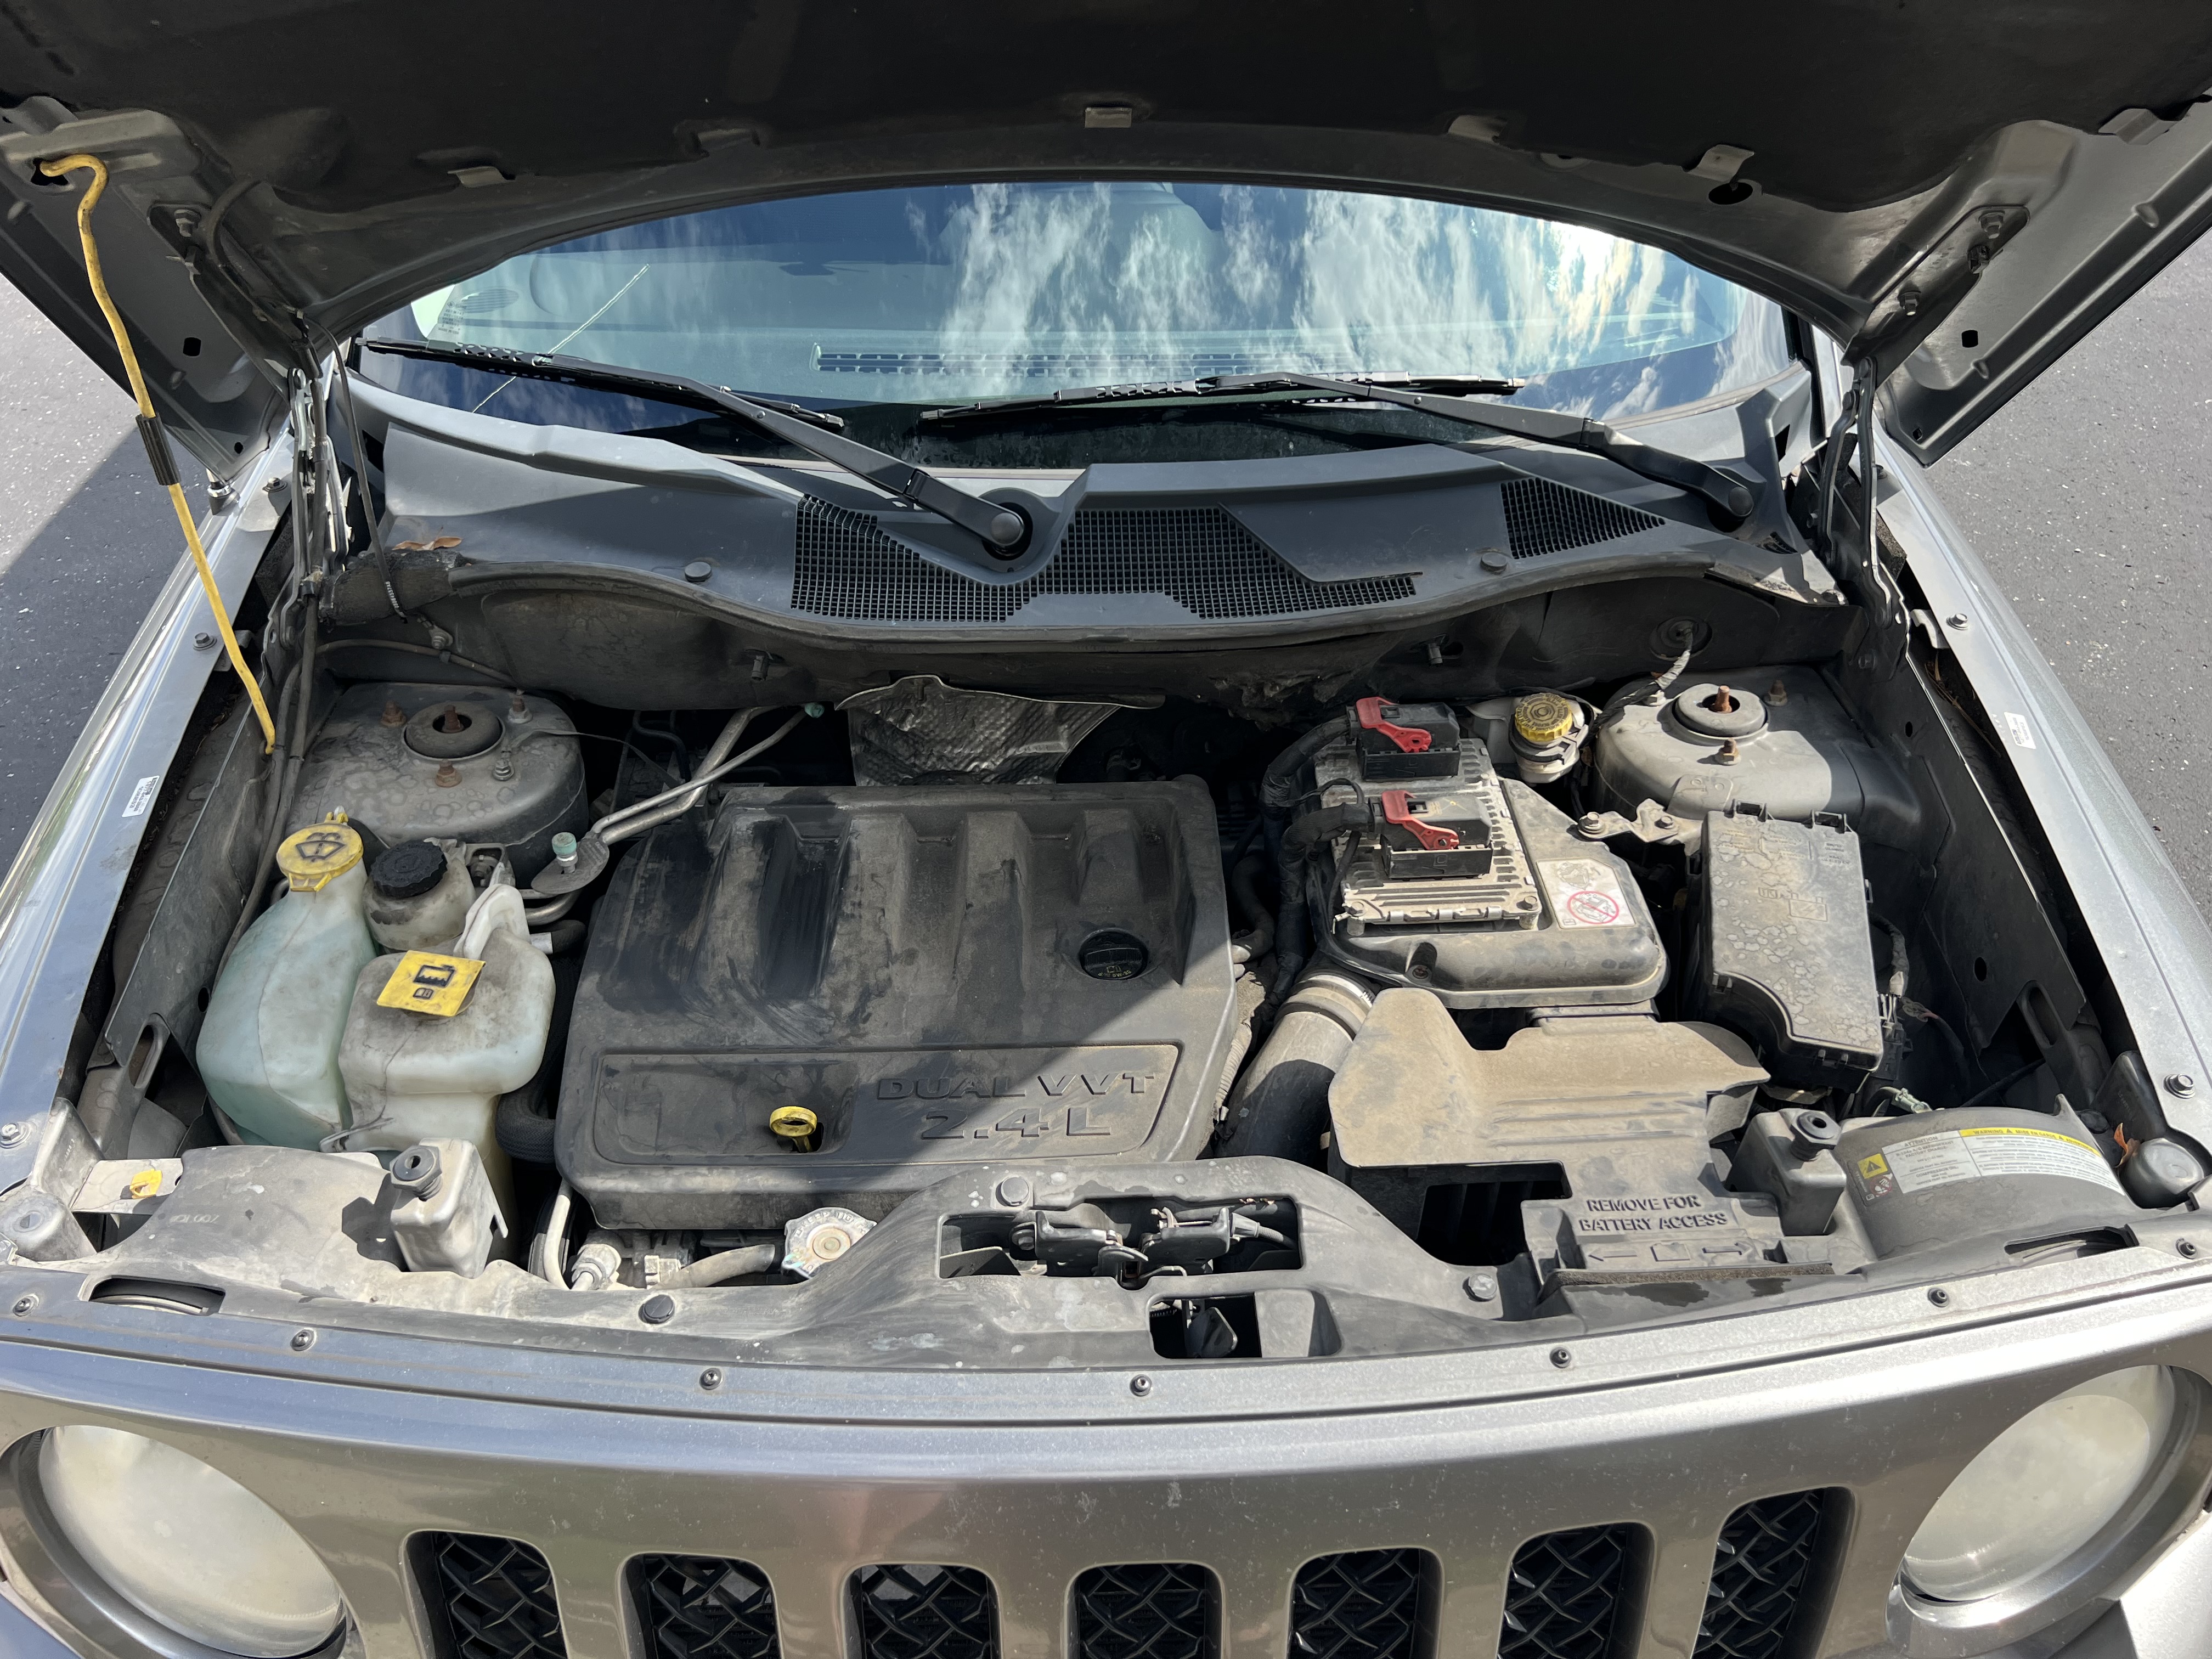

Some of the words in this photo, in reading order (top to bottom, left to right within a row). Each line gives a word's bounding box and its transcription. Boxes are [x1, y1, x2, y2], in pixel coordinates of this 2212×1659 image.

[877, 1076, 1026, 1099] DUAL
[1037, 1072, 1155, 1096] VVT
[1904, 1136, 1938, 1147] ATTENTION
[1922, 1141, 1954, 1150] REFRIGERANT
[1916, 1167, 1949, 1178] COMPRESSOR
[1586, 1198, 1662, 1212] REMOVE
[1662, 1195, 1702, 1210] FOR
[1578, 1217, 1652, 1232] BATTERY
[1658, 1212, 1728, 1229] ACCESS
